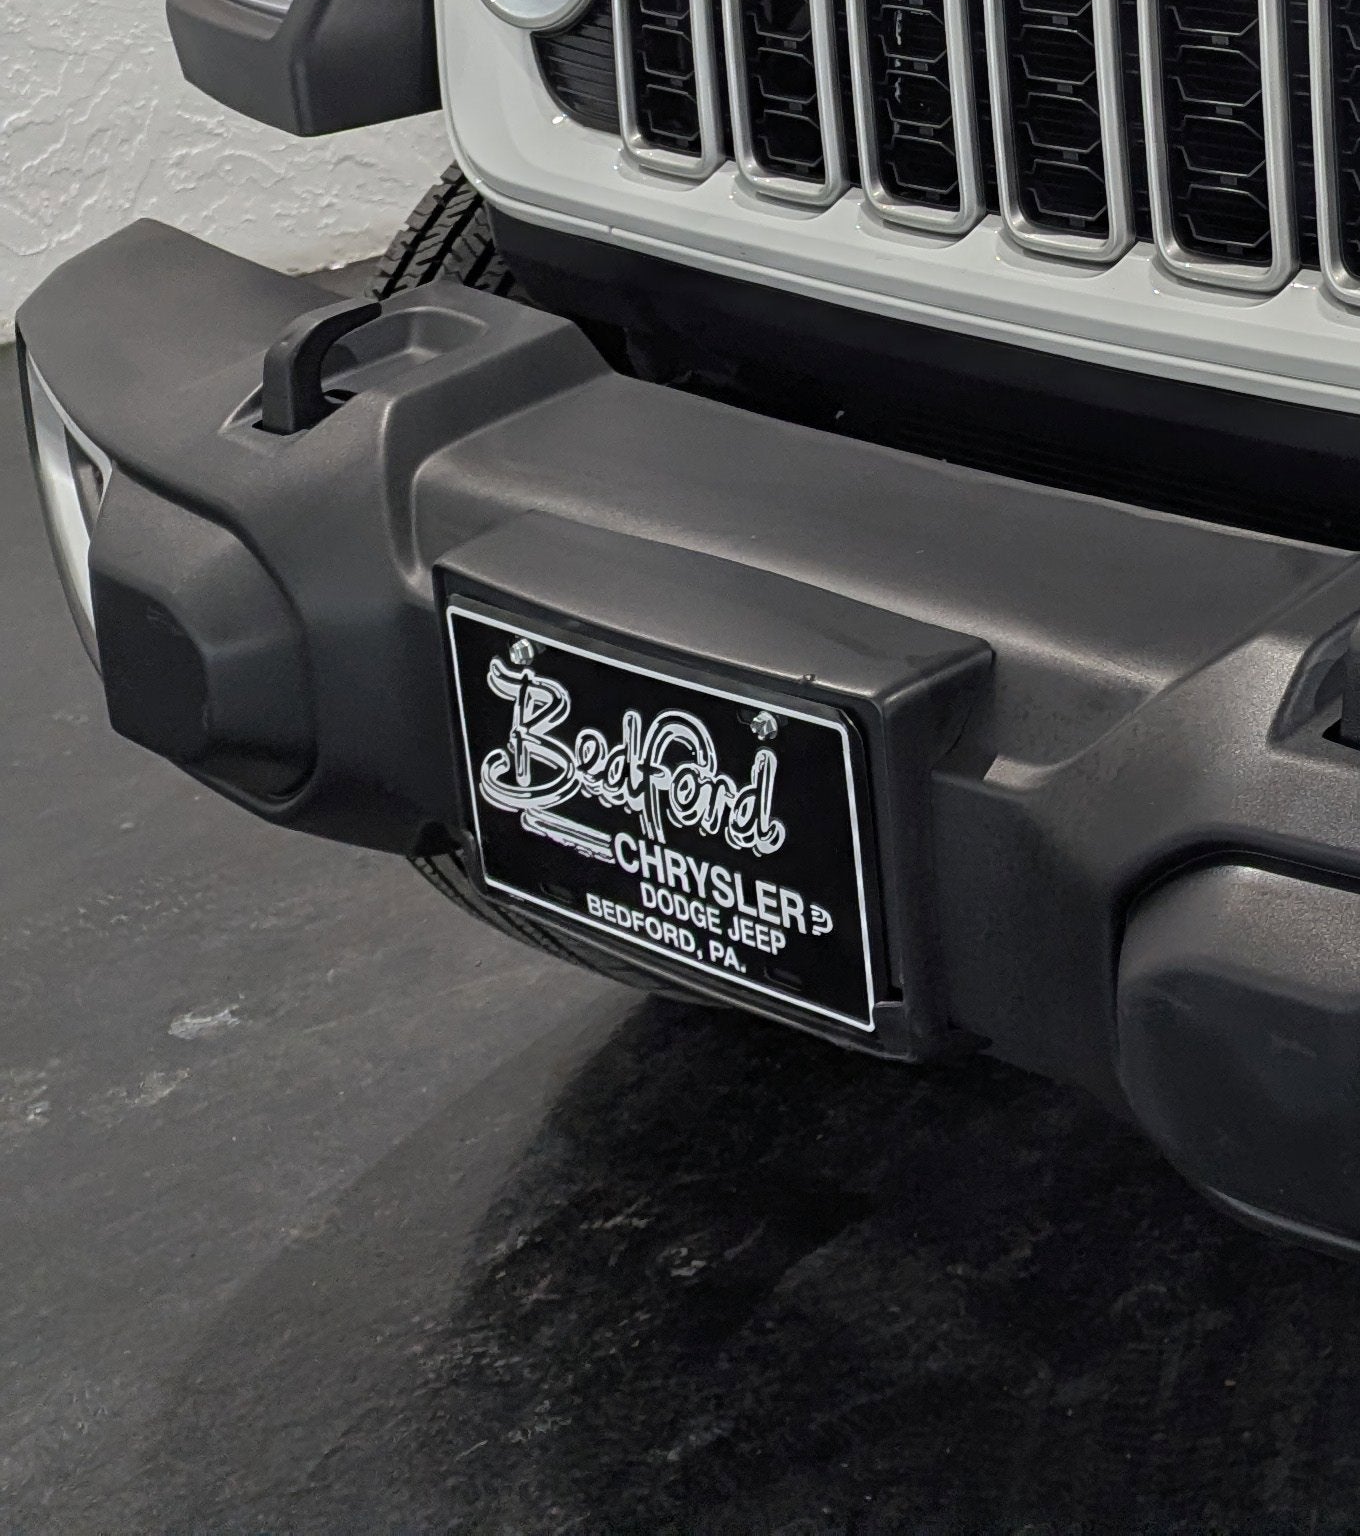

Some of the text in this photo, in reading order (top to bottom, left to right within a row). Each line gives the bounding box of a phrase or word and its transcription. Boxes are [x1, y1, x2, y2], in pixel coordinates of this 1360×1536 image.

[480, 656, 786, 857] Bedford
[613, 832, 807, 935] CHRYSLER
[639, 881, 787, 957] DODGE JEEP
[586, 893, 747, 973] BEDFORD, PA.
